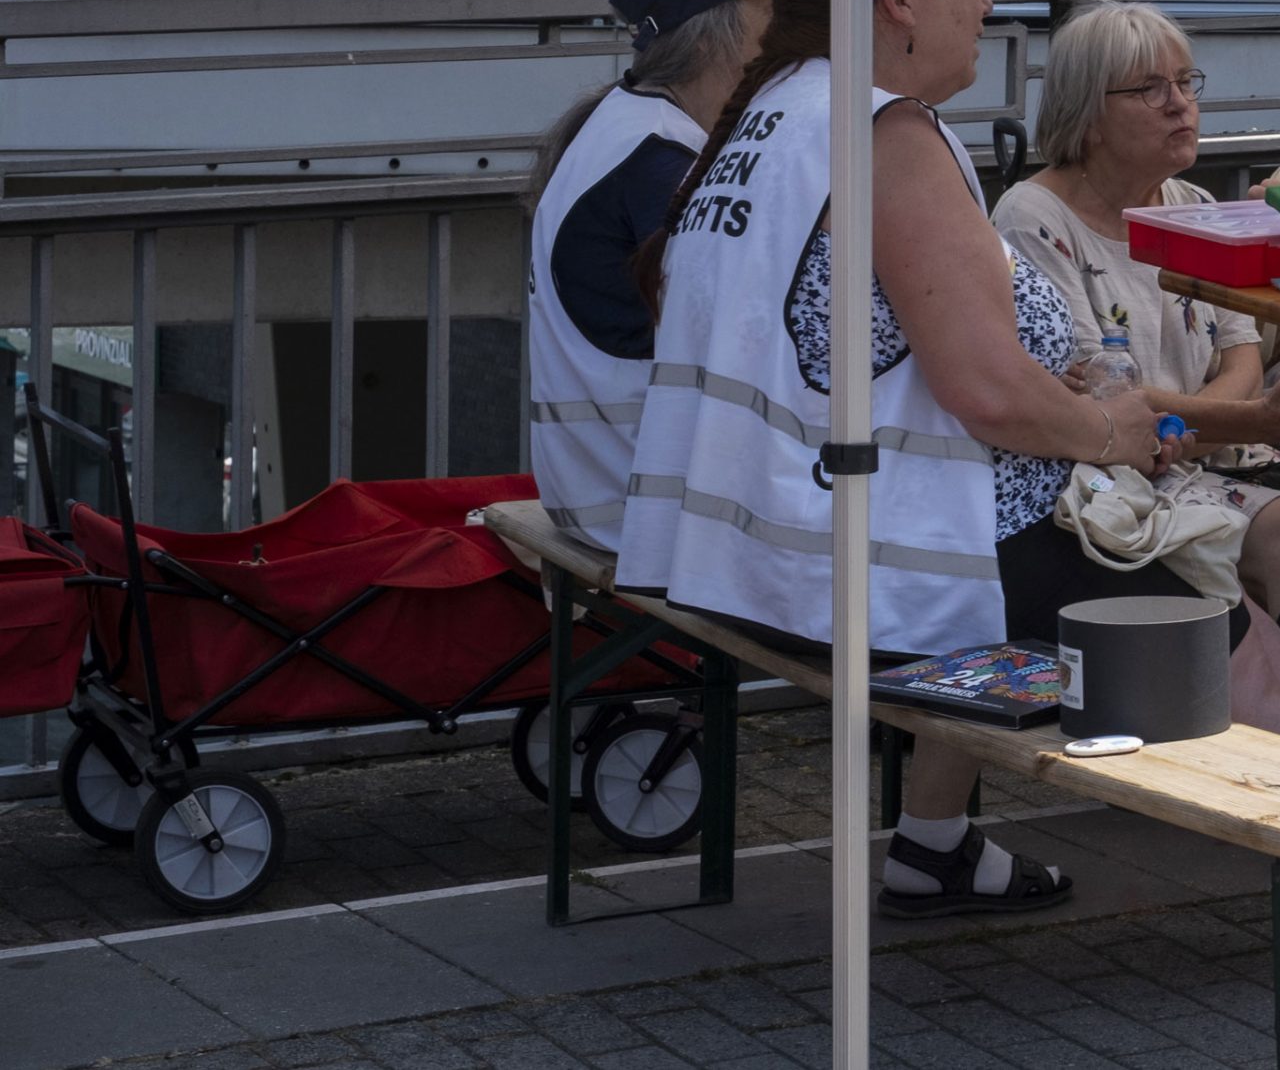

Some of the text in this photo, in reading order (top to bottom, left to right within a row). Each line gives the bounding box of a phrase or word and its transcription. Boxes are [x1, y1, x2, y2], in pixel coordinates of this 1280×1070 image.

[727, 110, 784, 144] MAS
[700, 151, 761, 187] GEN
[670, 195, 752, 237] CHTS
[75, 329, 132, 368] PROVINZIAL
[934, 669, 994, 688] 24
